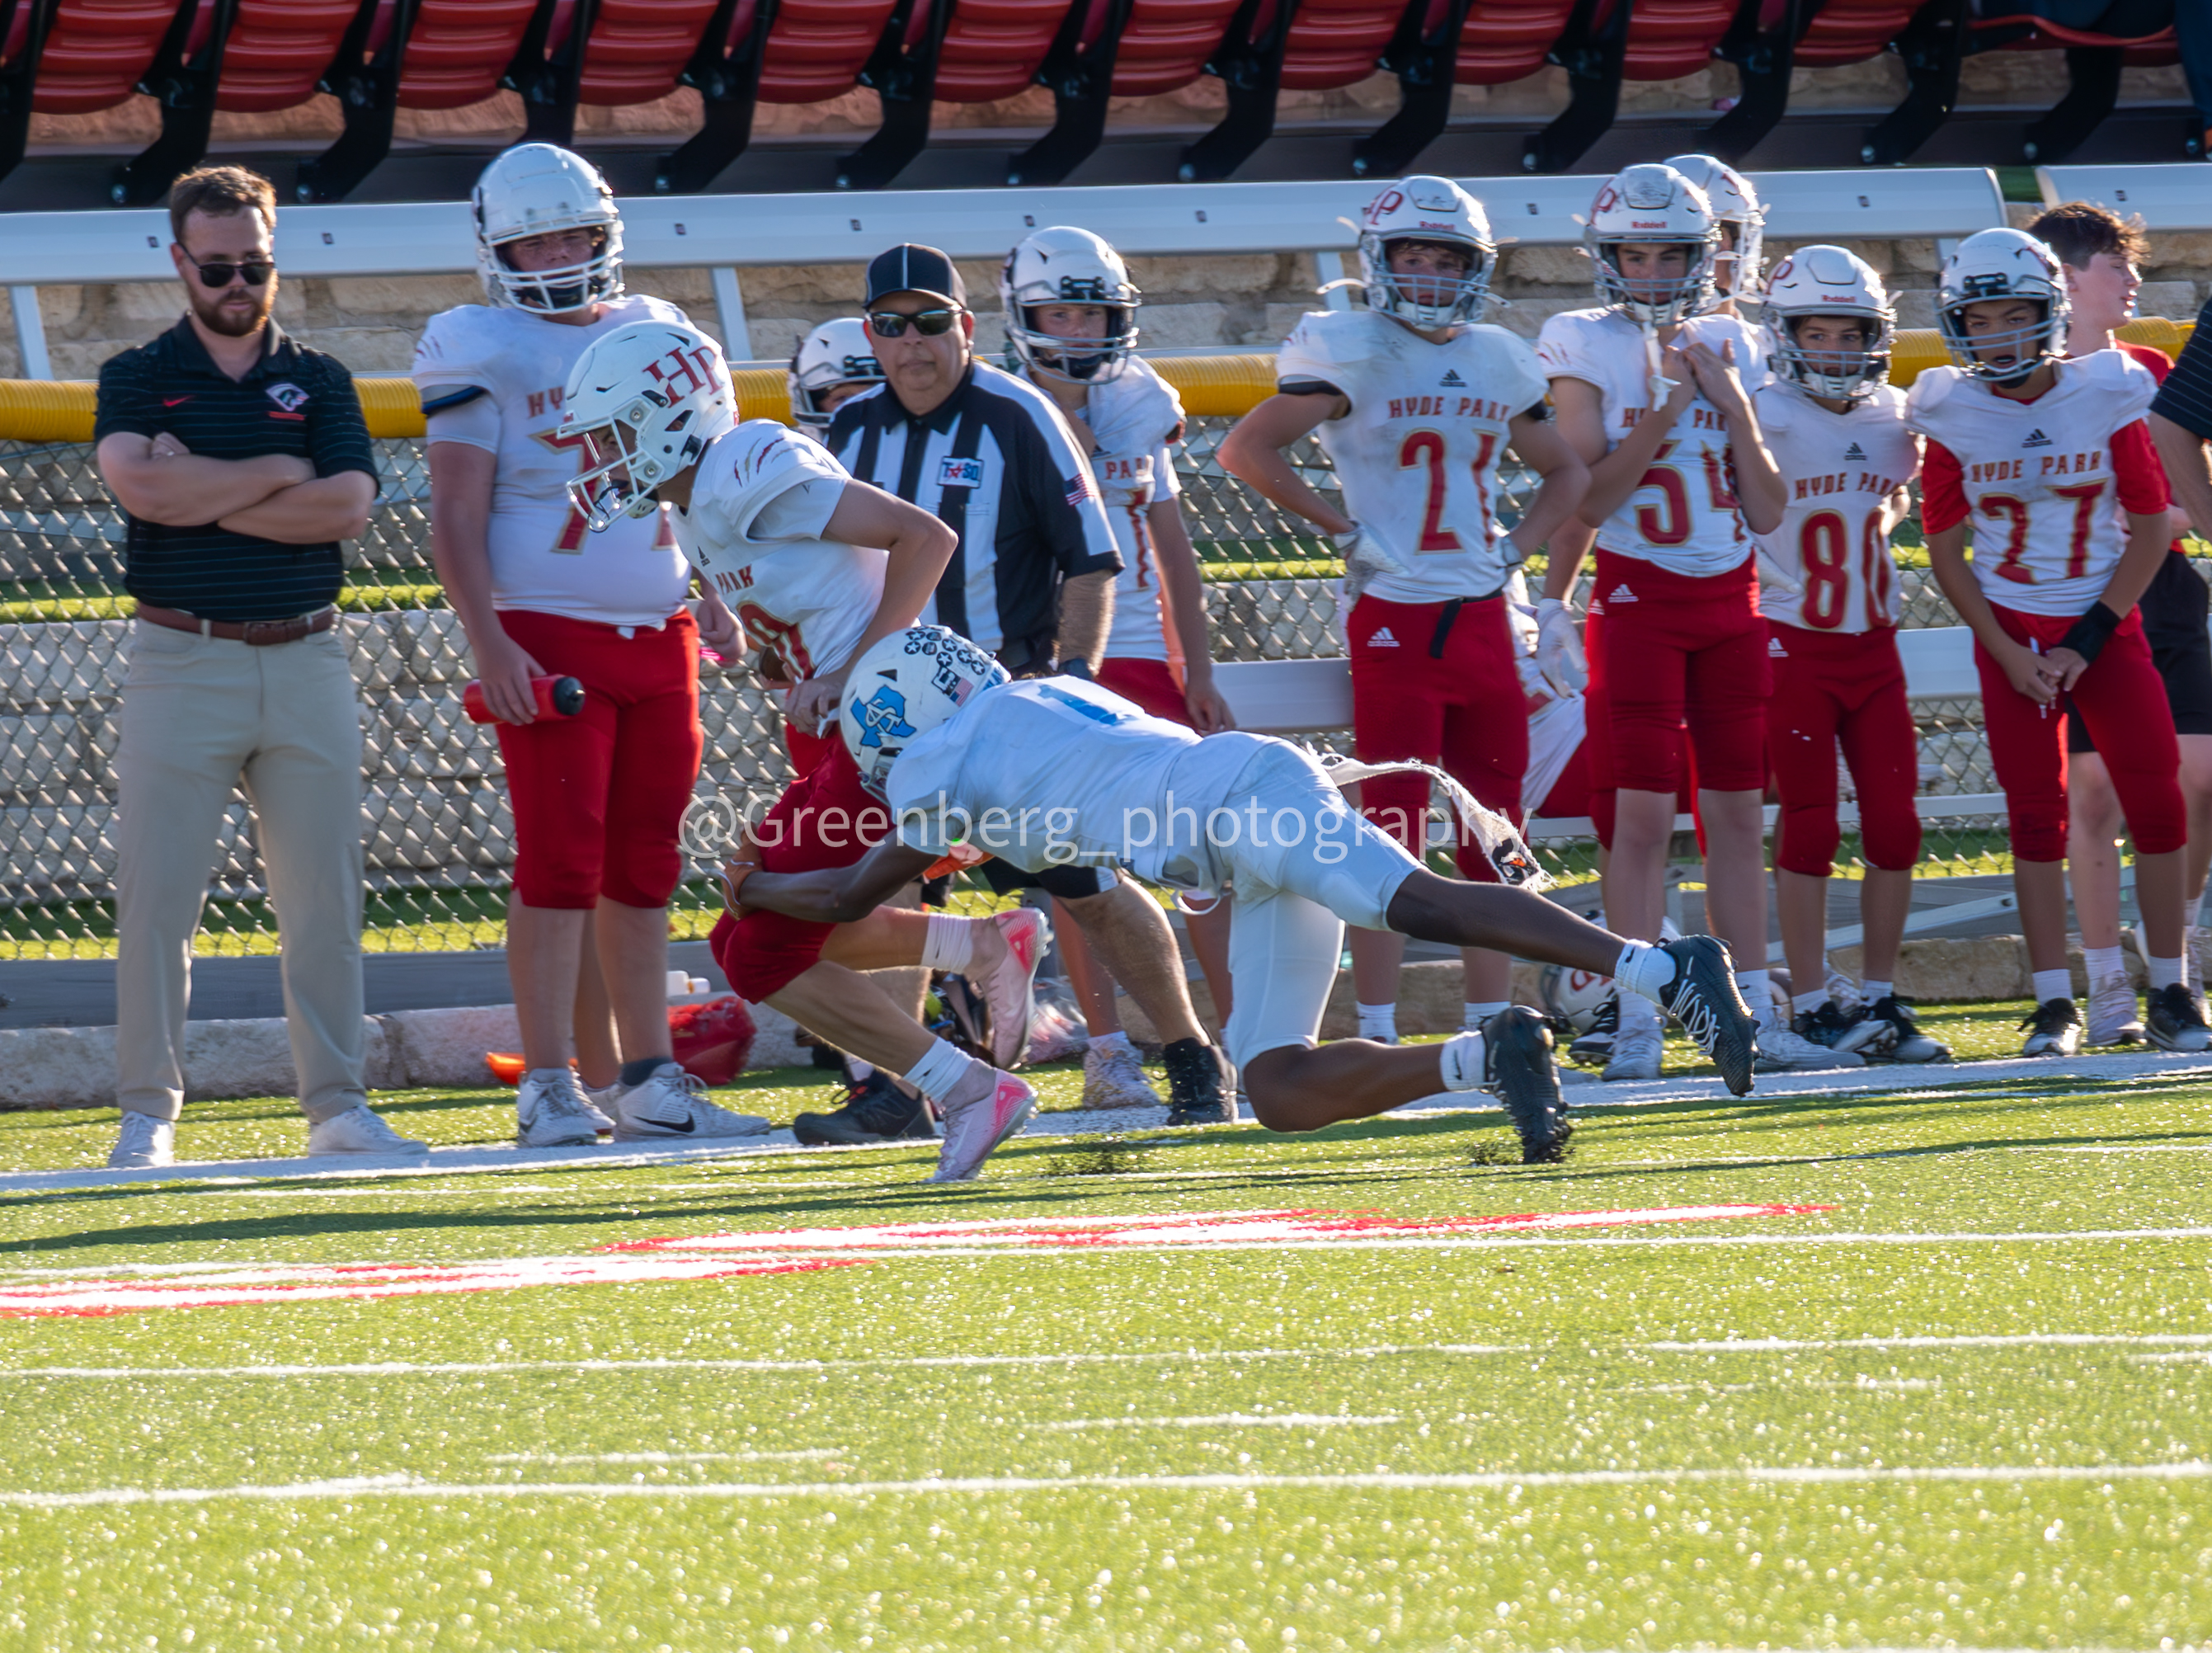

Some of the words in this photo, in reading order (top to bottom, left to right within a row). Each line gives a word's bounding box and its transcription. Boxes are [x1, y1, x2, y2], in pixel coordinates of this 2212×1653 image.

[1631, 221, 1667, 229] Riddell
[642, 346, 723, 409] HP
[527, 386, 563, 417] HY
[1388, 396, 1444, 419] HYDE
[1972, 459, 2025, 483] HYDE
[2041, 450, 2102, 476] PARK
[1397, 426, 1501, 556] 21
[1795, 472, 1847, 501] HYDE
[1978, 477, 2110, 586] 27
[1800, 507, 1894, 630] 80
